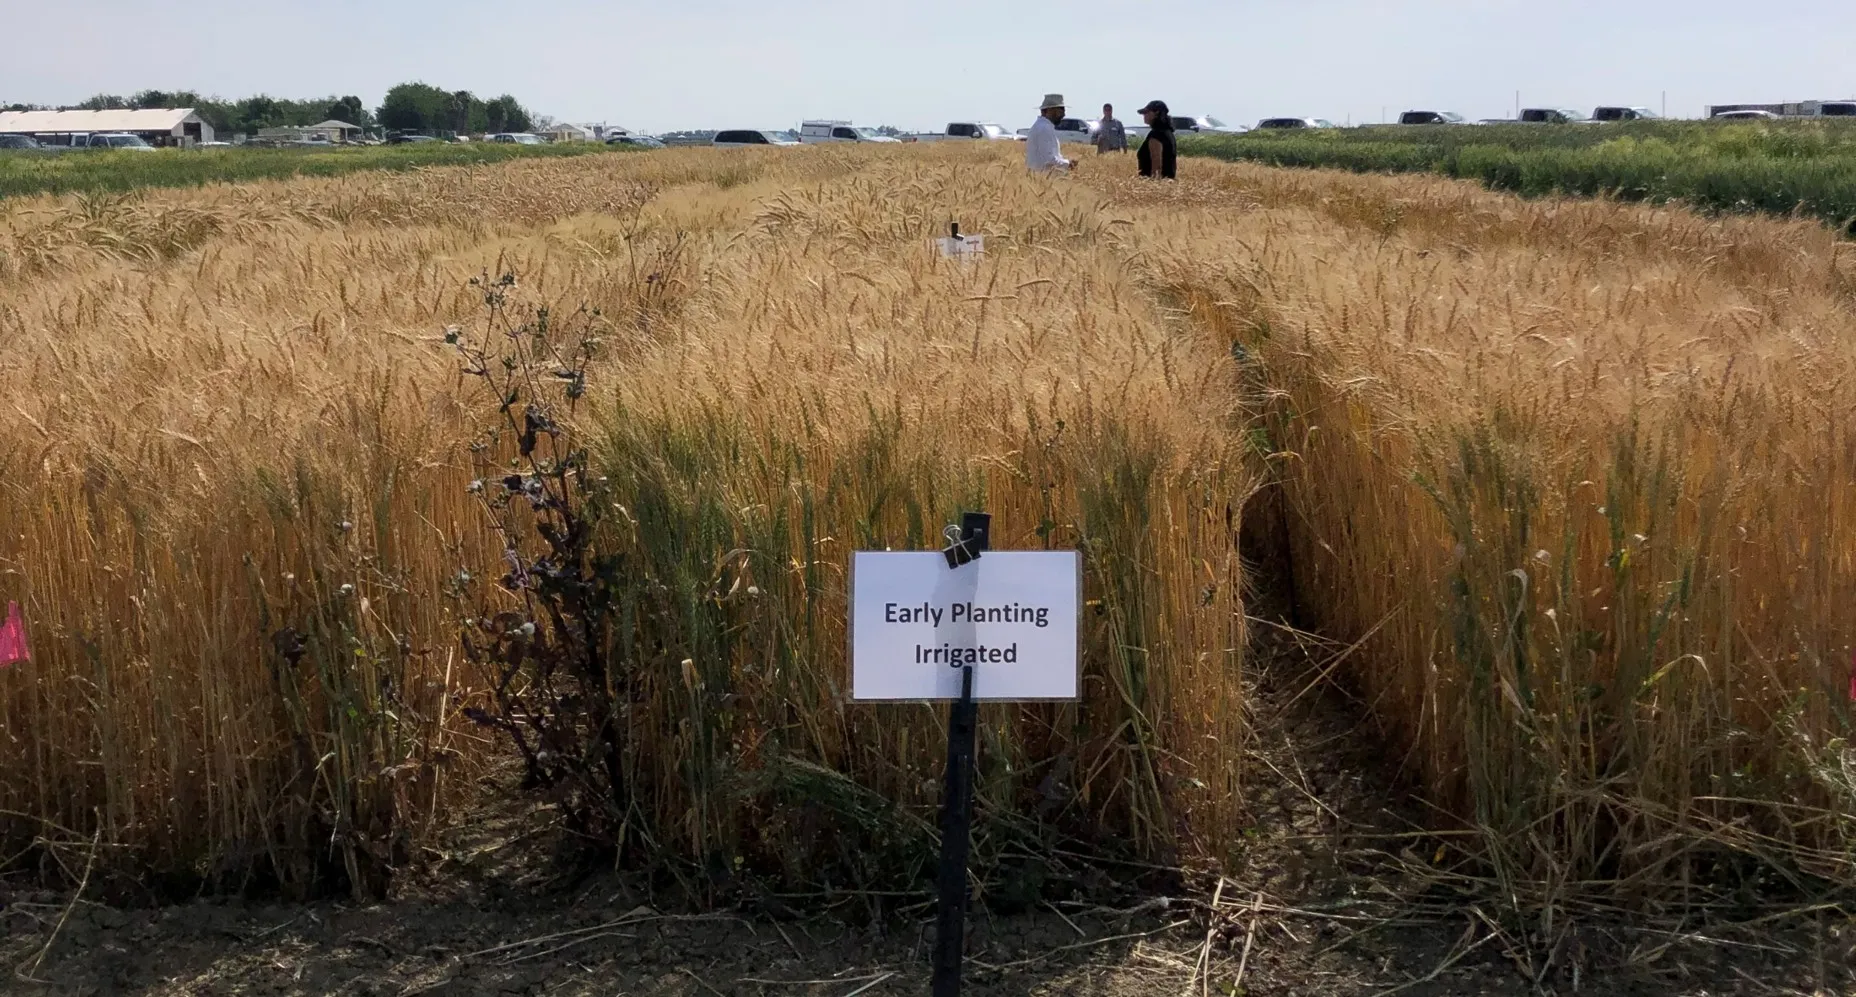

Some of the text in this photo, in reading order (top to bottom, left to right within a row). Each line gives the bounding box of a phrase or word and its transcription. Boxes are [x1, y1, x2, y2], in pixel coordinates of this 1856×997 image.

[885, 602, 1049, 627] Early Planting
[915, 643, 1017, 668] Irrigated
